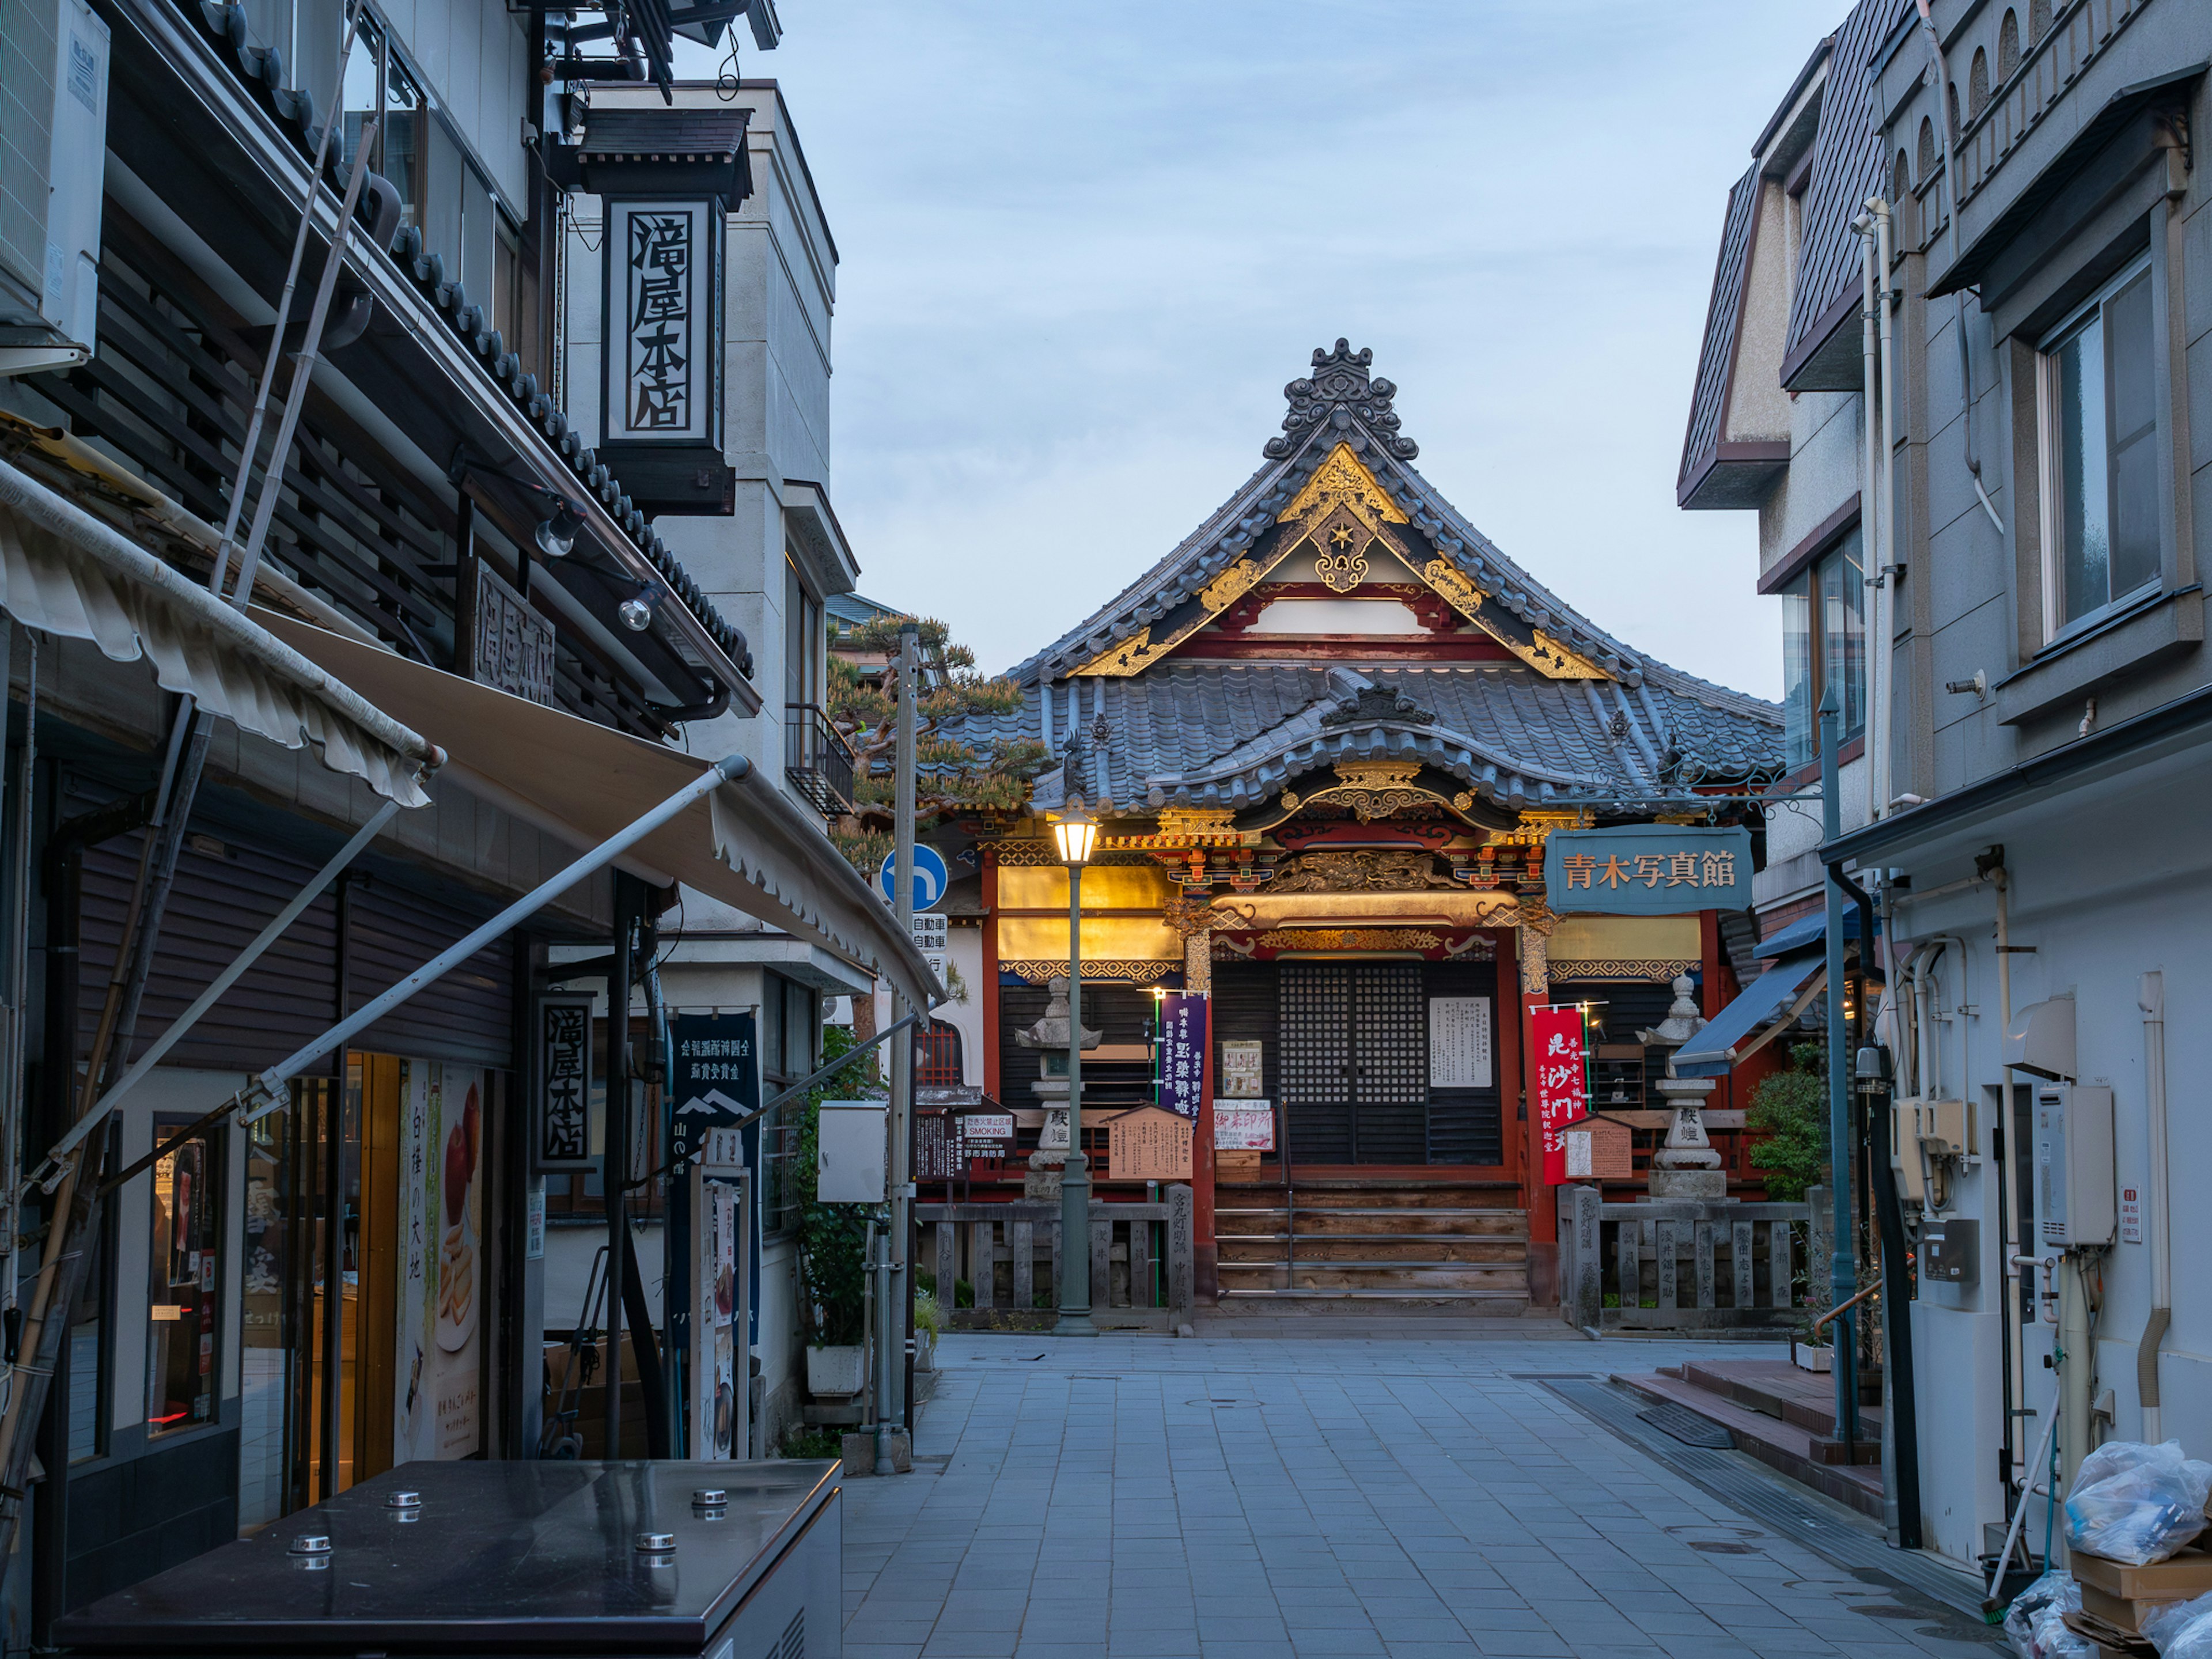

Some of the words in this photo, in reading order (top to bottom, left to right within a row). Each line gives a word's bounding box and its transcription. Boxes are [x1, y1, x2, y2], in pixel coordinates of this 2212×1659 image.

[632, 214, 688, 428] 滝屋本店
[1562, 850, 1736, 890] 青木写真館
[914, 918, 945, 931] 自動車
[914, 935, 945, 948] 自動車
[548, 1010, 584, 1156] 滝屋本店
[1568, 1037, 1582, 1110] 善光寺七福神
